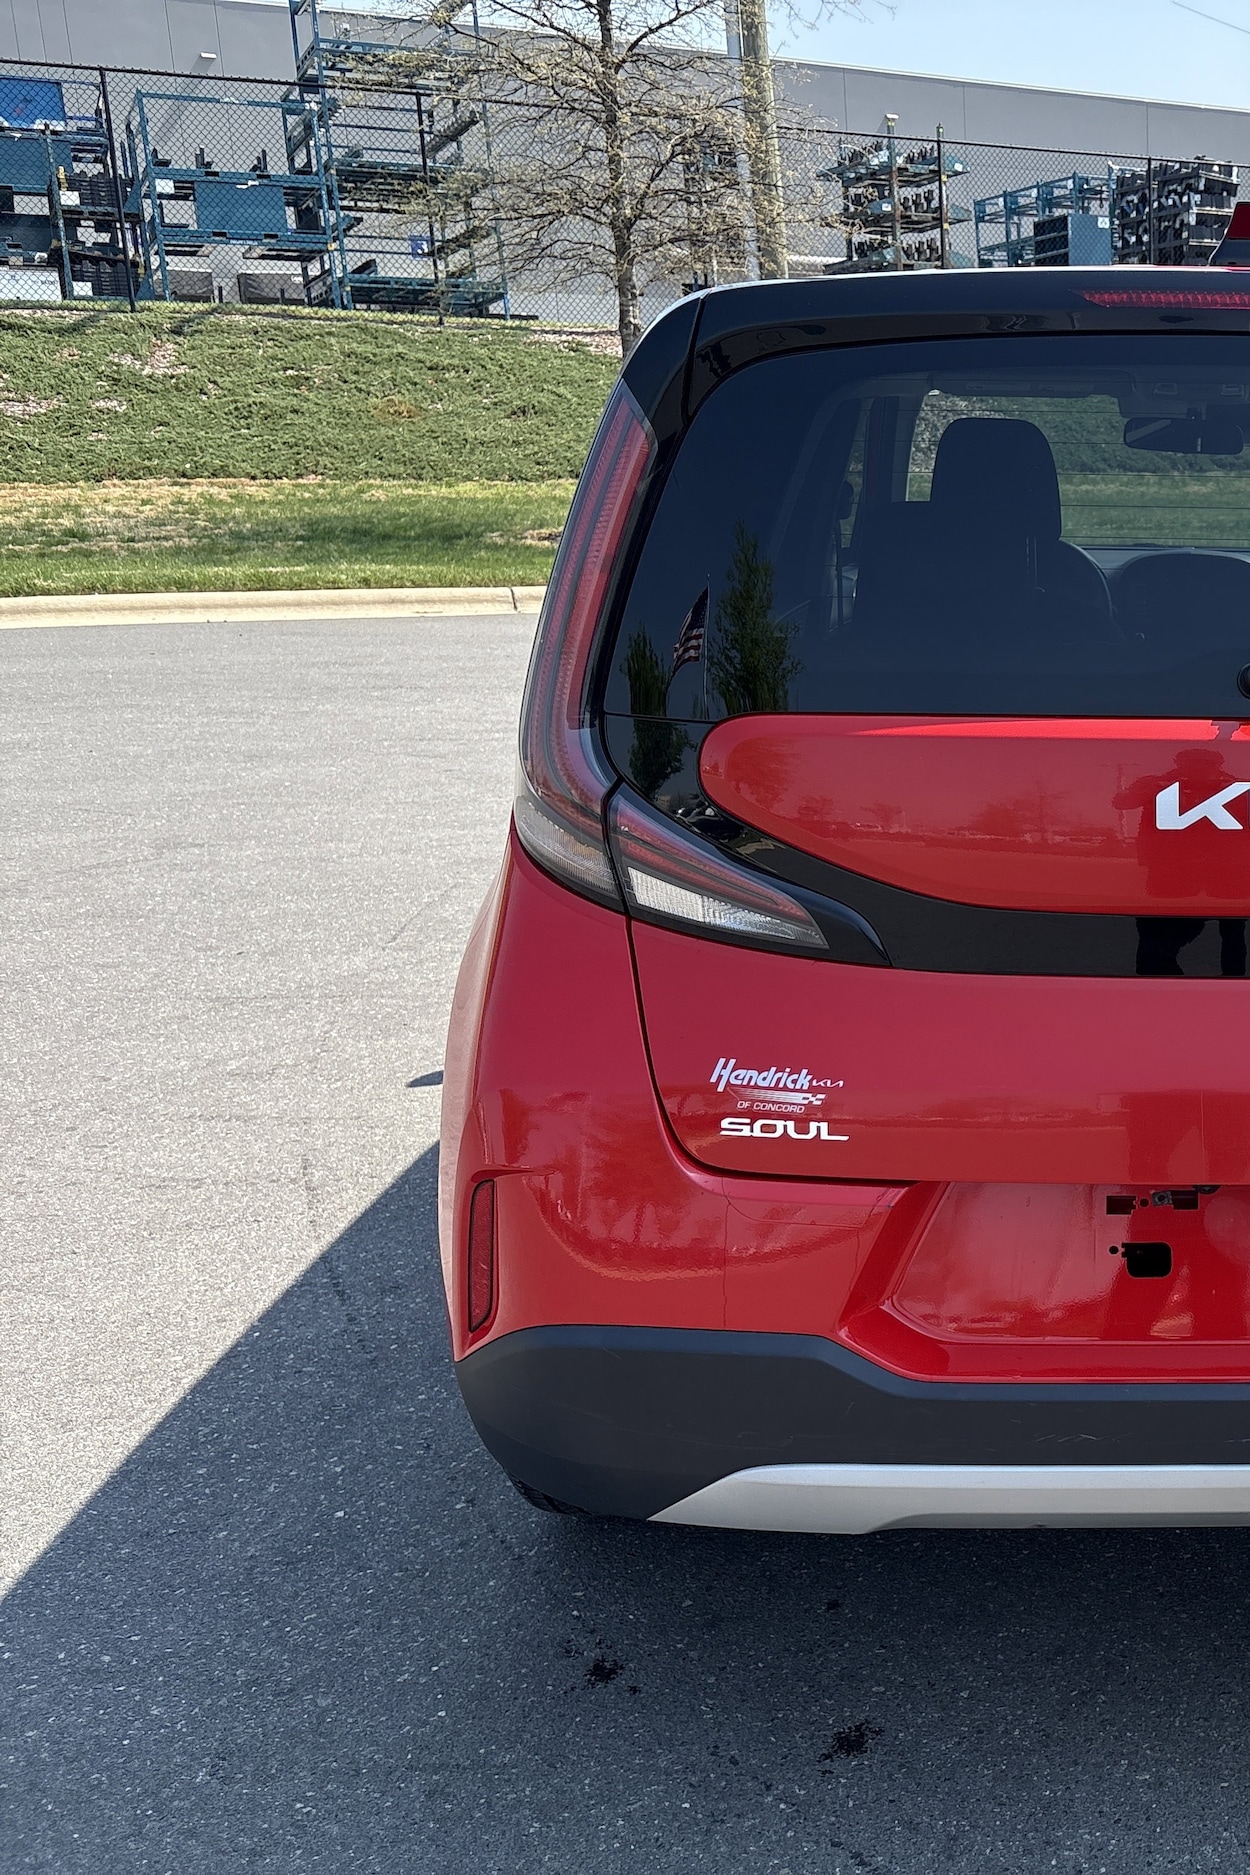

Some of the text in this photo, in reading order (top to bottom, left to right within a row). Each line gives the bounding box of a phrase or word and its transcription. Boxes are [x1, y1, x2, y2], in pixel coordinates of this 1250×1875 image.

[710, 1057, 844, 1092] Hendrick KIA
[737, 1100, 805, 1114] OF CONCORD
[720, 1117, 850, 1141] SOUL
